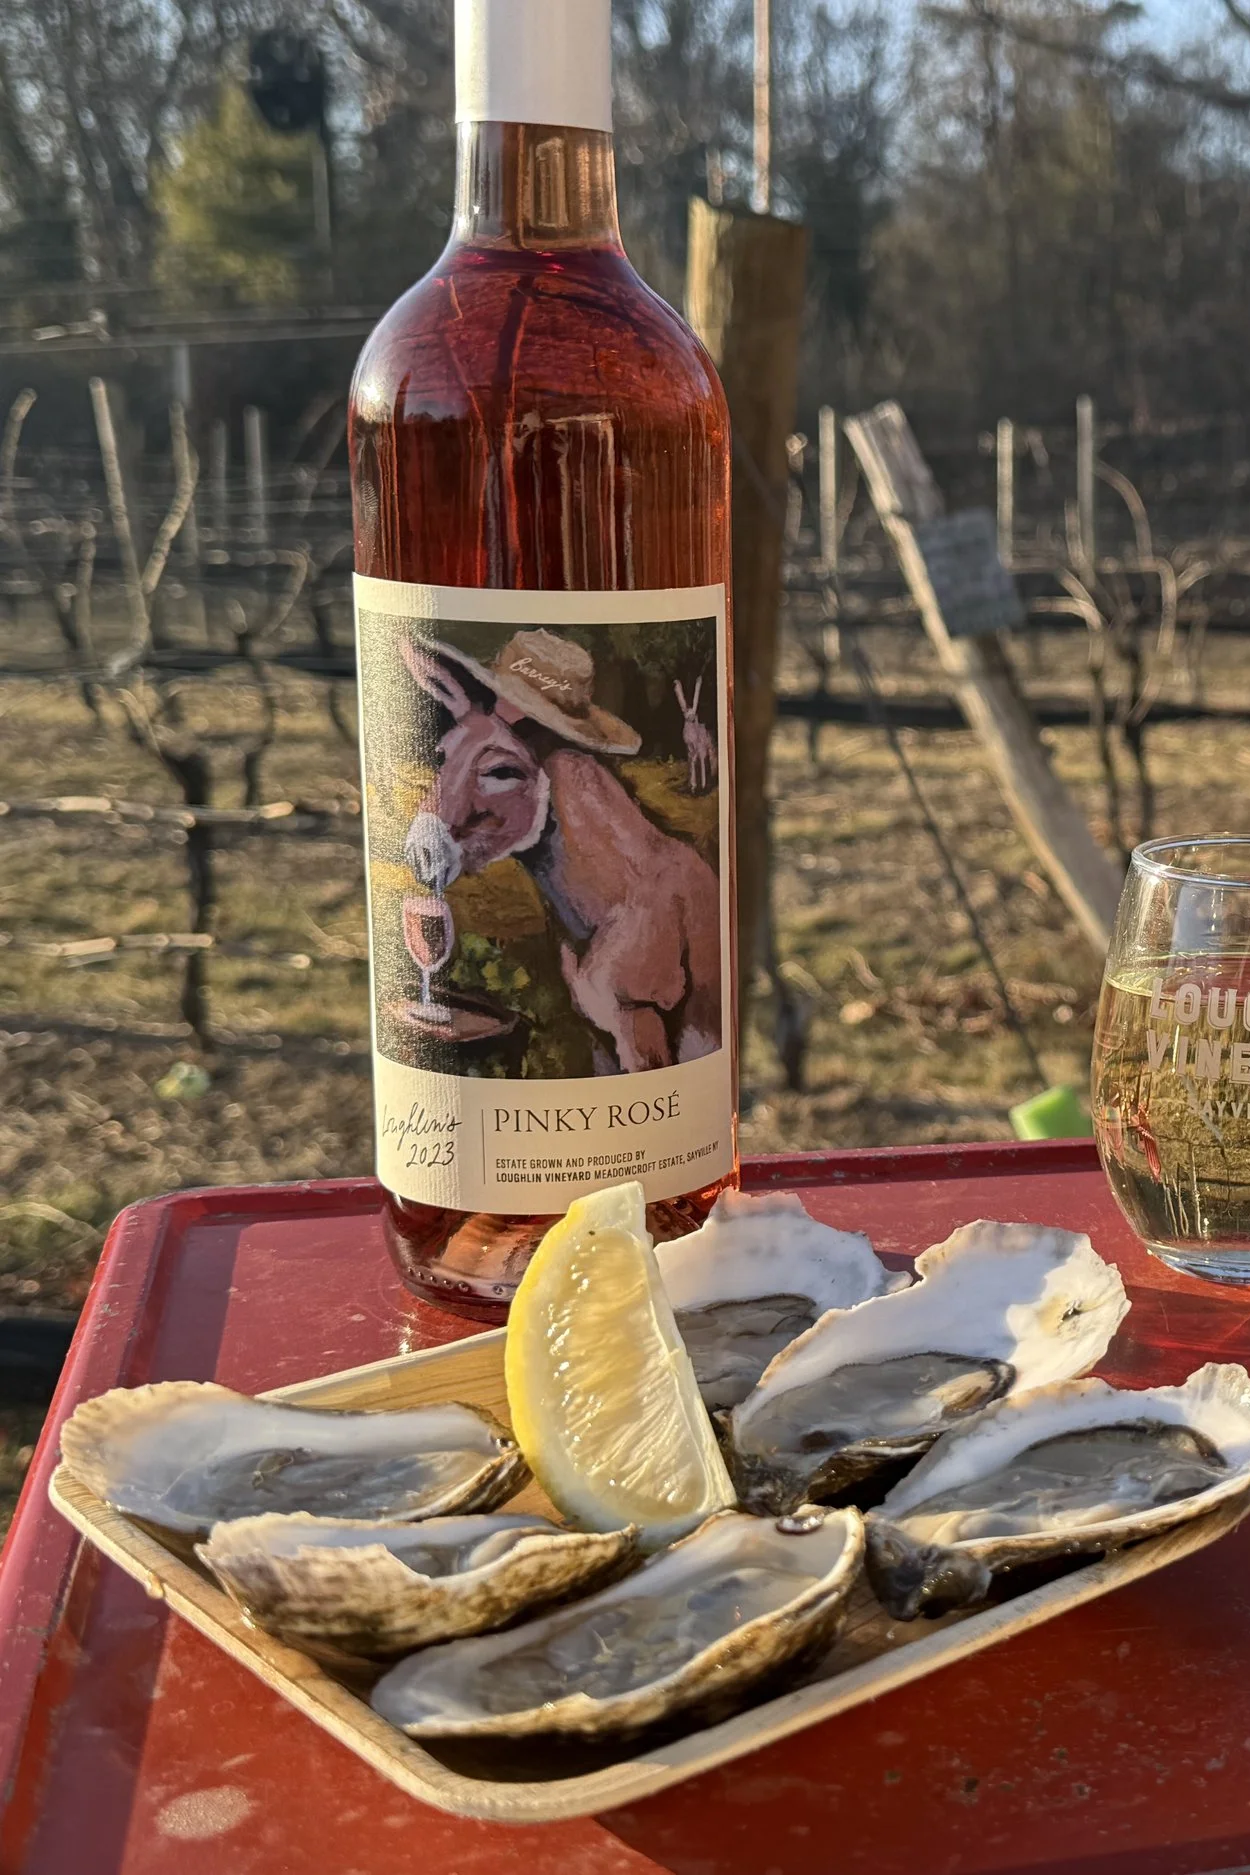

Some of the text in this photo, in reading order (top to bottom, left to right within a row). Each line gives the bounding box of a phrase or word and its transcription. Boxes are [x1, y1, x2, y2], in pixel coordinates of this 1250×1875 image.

[494, 1090, 681, 1134] PINKY ROSÉ
[406, 1141, 455, 1168] 2023
[495, 1150, 646, 1169] ESTATE GROWN AND PRODUCED BY
[496, 1140, 720, 1183] LOUGHLIN VINEYARD MEADOWCROFT ESTATE, SAYVILLE NY
